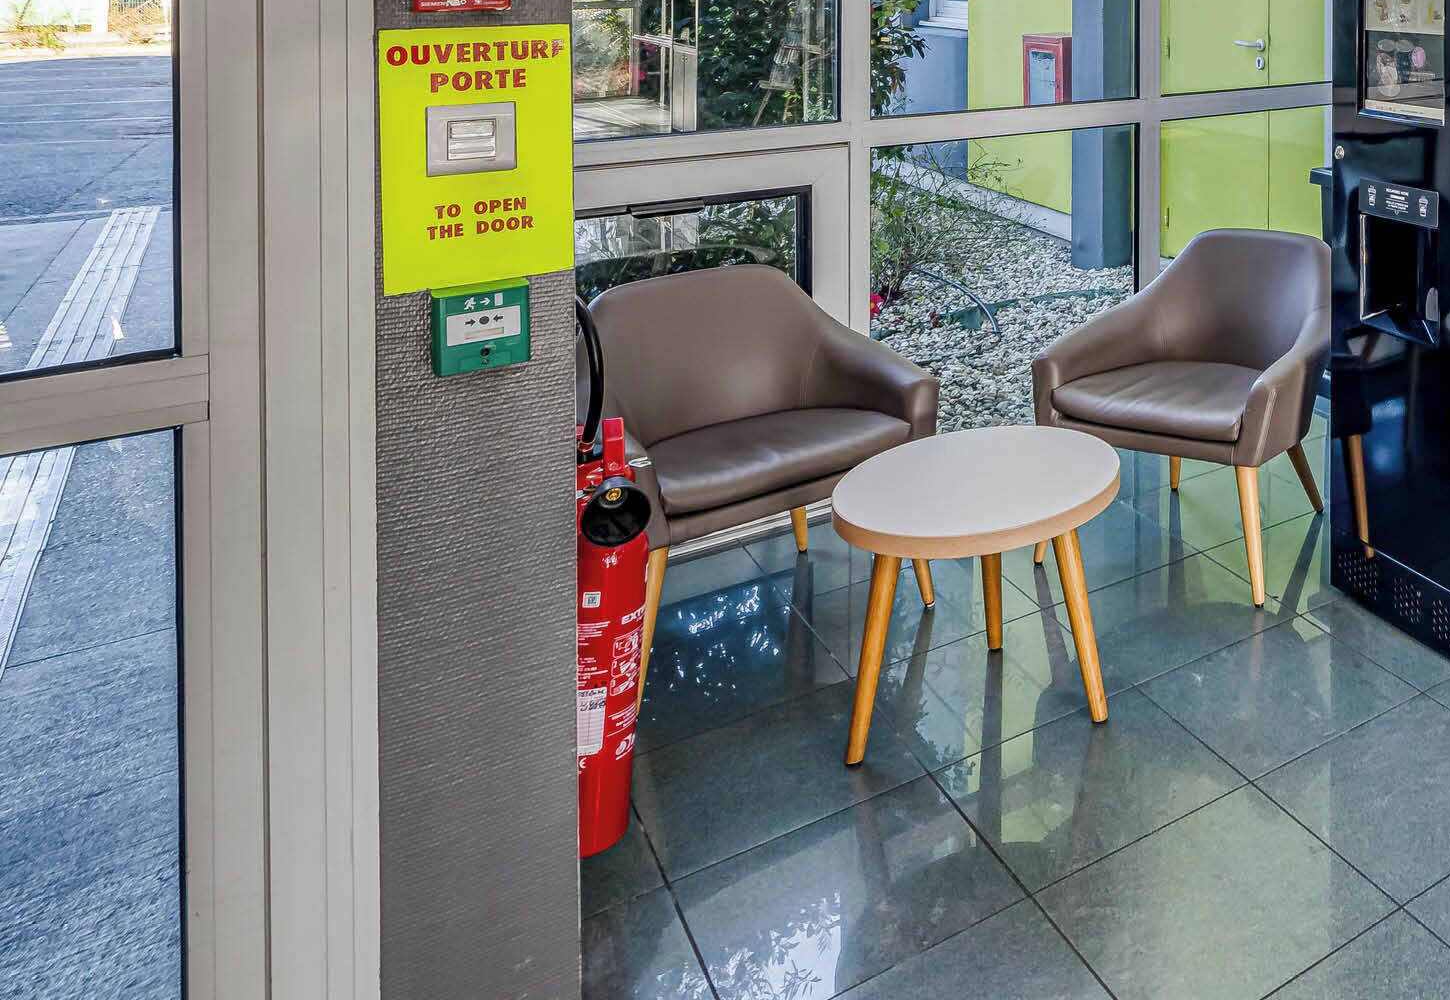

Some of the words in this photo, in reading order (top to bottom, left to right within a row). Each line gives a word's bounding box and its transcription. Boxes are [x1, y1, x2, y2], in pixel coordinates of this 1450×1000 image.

[430, 69, 527, 94] PORTE
[435, 204, 462, 220] TO
[473, 196, 527, 216] OPEN
[427, 223, 465, 241] THE
[476, 215, 535, 235] DOOR
